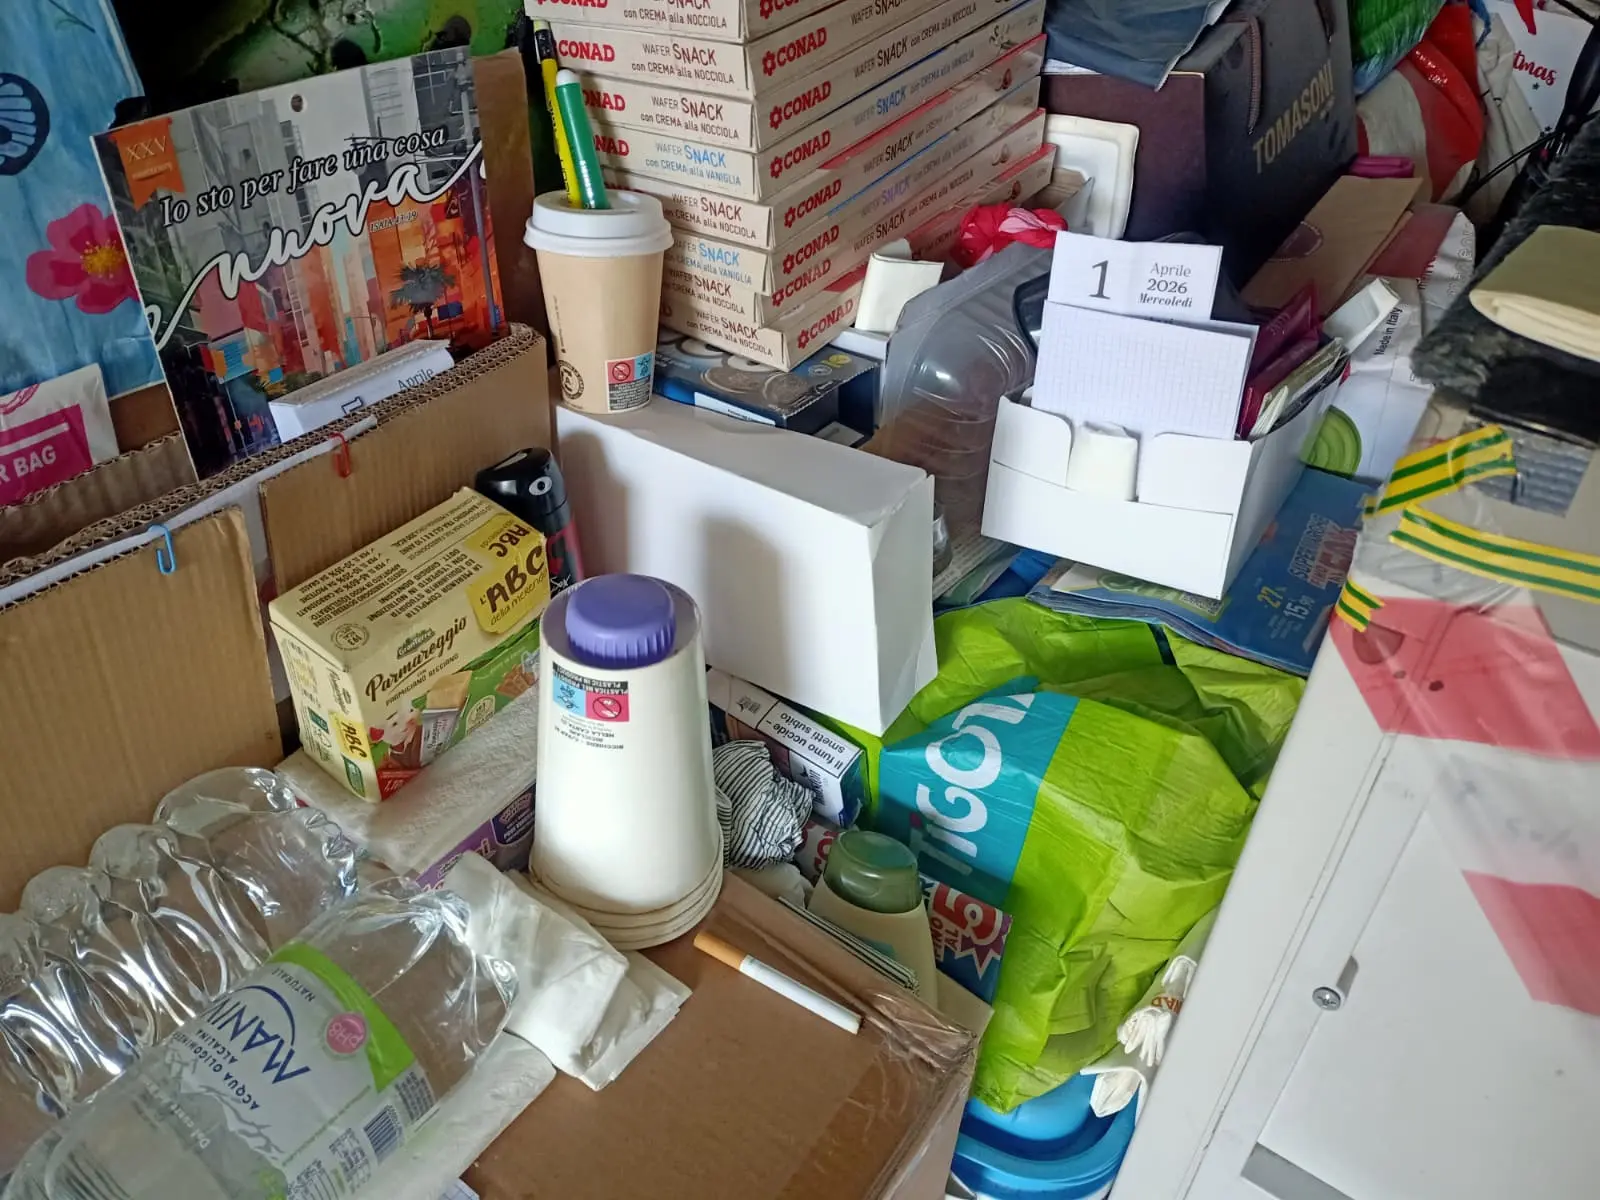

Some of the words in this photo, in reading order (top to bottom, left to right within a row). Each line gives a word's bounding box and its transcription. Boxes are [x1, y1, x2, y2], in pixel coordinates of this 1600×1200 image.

[624, 9, 637, 19] con
[640, 8, 666, 21] CREMA
[668, 13, 685, 24] alla
[686, 13, 727, 28] NOCCIOLA
[559, 40, 615, 62] CONAD
[643, 43, 671, 56] WAFER
[672, 43, 717, 66] SNACK
[777, 27, 826, 67] CONAD
[877, 36, 908, 67] SNACK
[632, 63, 645, 72] con
[648, 62, 674, 76] CREMA
[677, 67, 692, 78] alla
[694, 69, 734, 84] NOCCIOLA
[1513, 50, 1557, 86] tmas
[651, 96, 678, 109] WAFER
[680, 97, 723, 121] SNACK
[783, 80, 832, 121] CONAD
[876, 85, 907, 116] SNACK
[641, 113, 653, 122] con
[655, 113, 682, 127] CREMA
[684, 120, 699, 132] alla
[701, 123, 739, 139] NOCCIOLA
[1253, 58, 1335, 174] TOMASONI
[126, 135, 167, 162] XXV
[593, 134, 629, 157] NAD
[656, 142, 682, 156] WAFER
[684, 144, 726, 168] SNACK
[783, 129, 831, 170] CONAD
[885, 130, 914, 162] SNACK
[159, 194, 190, 228] Io
[196, 180, 235, 215] sto
[240, 170, 284, 209] per
[286, 154, 338, 193] fare
[343, 142, 389, 171] una
[393, 125, 447, 157] cosa
[661, 159, 687, 173] CREMA
[705, 168, 741, 186] VANIGLIA
[700, 197, 741, 221] SNACK
[796, 179, 842, 218] CONAD
[185, 152, 462, 312] nuova
[675, 209, 701, 224] CREMA
[719, 222, 756, 239] NOCCIOLA
[876, 208, 906, 239] SNACK
[699, 243, 739, 266] SNACK
[796, 225, 839, 263] CONAD
[783, 258, 831, 297] CONAD
[1089, 259, 1110, 300] 1
[1150, 262, 1192, 278] Aprile
[694, 274, 731, 297] SNACK
[1146, 278, 1188, 294] 2026
[712, 296, 745, 315] NOCCIOLA
[1387, 306, 1403, 326] Italy
[720, 317, 758, 340] SNACK
[808, 299, 854, 339] CONAD
[1386, 327, 1394, 336] in
[739, 337, 773, 357] NOCCIOLA
[1374, 335, 1392, 355] Made
[398, 367, 434, 391] Aprile
[13, 445, 56, 477] BAG
[489, 524, 529, 557] ABC
[365, 616, 467, 702] Parmareggio
[773, 723, 808, 747] uccide
[780, 712, 812, 734] subito
[341, 720, 368, 759] ABC
[814, 731, 846, 754] smetti
[808, 745, 834, 765] fumo
[834, 761, 844, 771] Il
[945, 929, 958, 950] AL
[196, 1029, 237, 1064] ALCALINA
[224, 1072, 259, 1110] ACQUA
